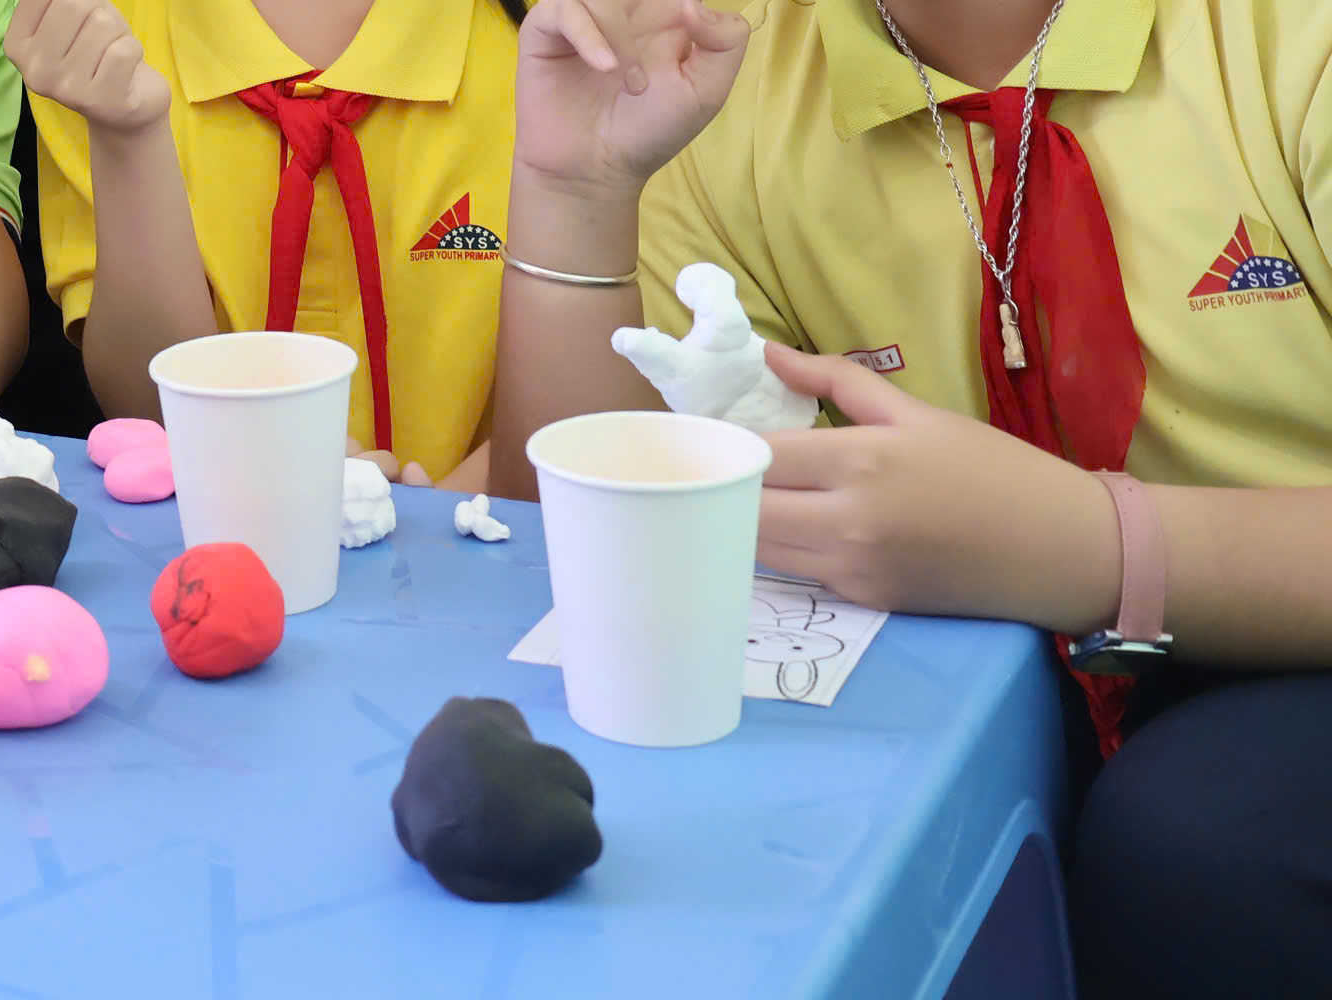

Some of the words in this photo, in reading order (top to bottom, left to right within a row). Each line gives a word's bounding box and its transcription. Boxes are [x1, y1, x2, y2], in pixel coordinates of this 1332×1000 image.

[453, 236, 488, 249] SYS
[409, 251, 435, 262] SUPER
[436, 250, 463, 260] YOUTH
[464, 251, 500, 261] PRIMARY
[1247, 270, 1287, 288] SYS
[1188, 295, 1226, 312] SUPER
[1227, 291, 1264, 306] YOUTH
[1265, 286, 1307, 302] PRIMARY
[874, 353, 894, 367] 5.1
